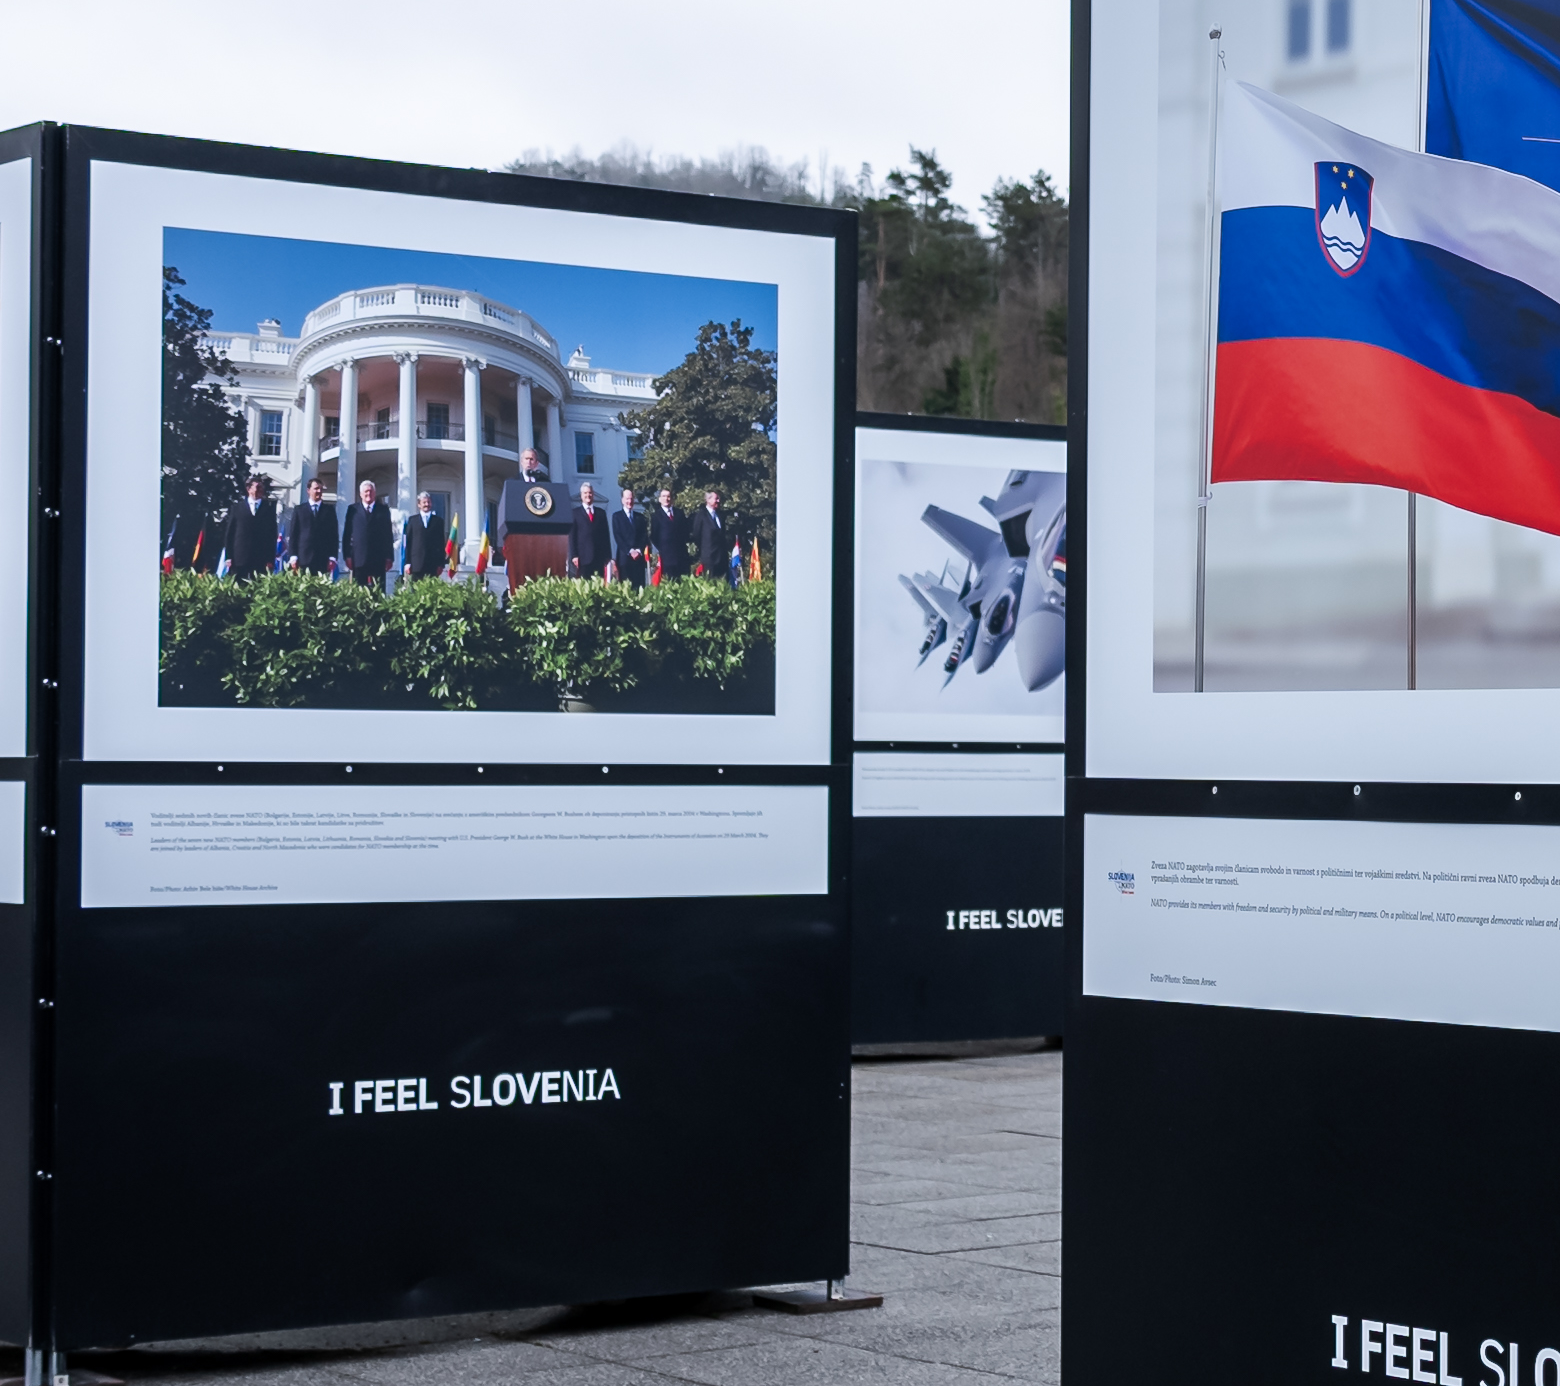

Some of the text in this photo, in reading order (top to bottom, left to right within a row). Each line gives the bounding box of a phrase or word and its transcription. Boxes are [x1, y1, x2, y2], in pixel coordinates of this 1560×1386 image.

[946, 908, 1063, 930] I FEEL SLOVE
[1436, 912, 1455, 922] NATO
[1456, 916, 1489, 926] encourages
[1490, 914, 1523, 925] democratic
[1525, 916, 1544, 926] values
[1545, 917, 1558, 927] and
[329, 1068, 621, 1115] I FEEL SLOVENIA
[1331, 1314, 1348, 1369] I
